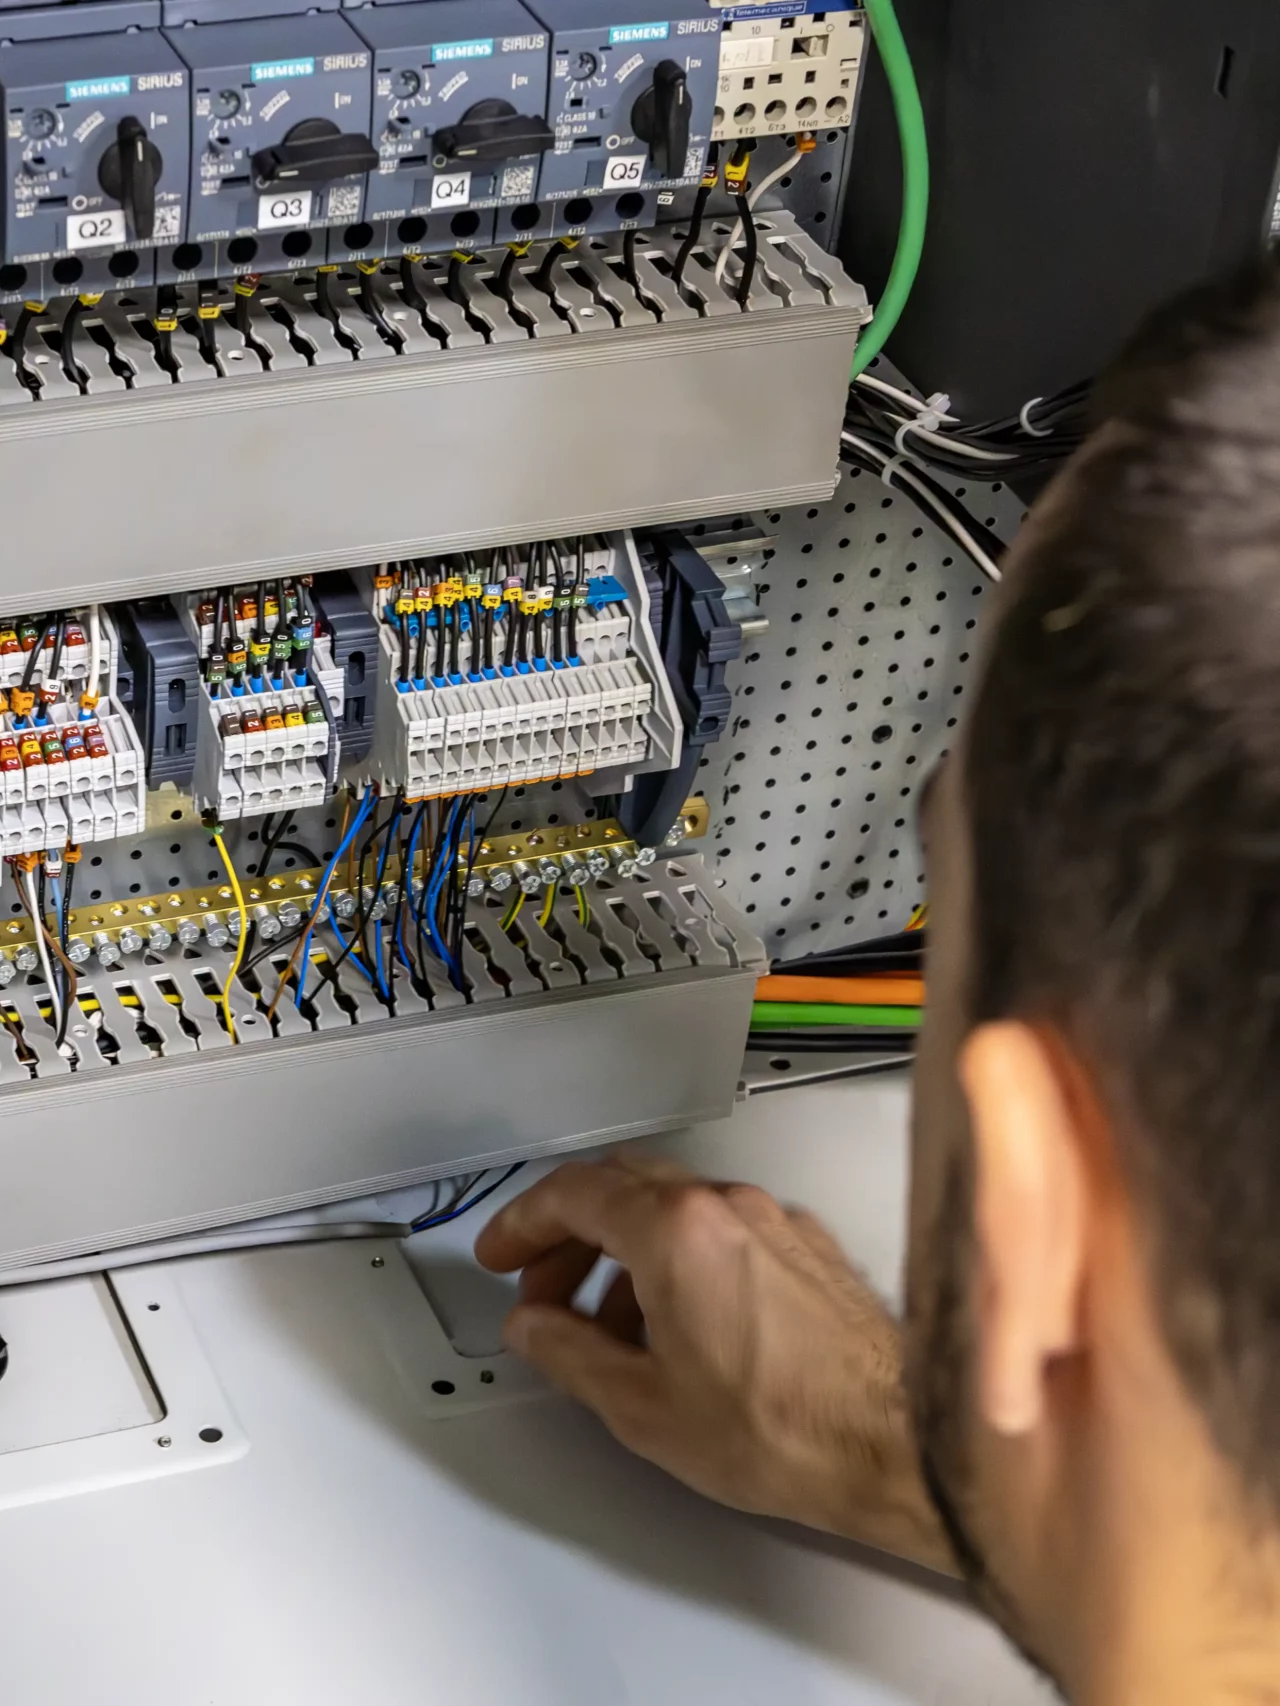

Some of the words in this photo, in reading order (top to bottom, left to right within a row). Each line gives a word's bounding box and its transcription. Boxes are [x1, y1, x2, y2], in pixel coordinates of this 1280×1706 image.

[612, 26, 667, 42] SIEMENS
[676, 19, 719, 36] SIRIUS
[751, 25, 762, 36] 10
[434, 44, 492, 61] SIEMENS
[501, 34, 545, 53] SIRIUS
[254, 63, 314, 80] SIEMENS
[322, 53, 368, 72] SIRIUS
[69, 82, 128, 98] SIEMENS
[137, 72, 183, 91] SIRIUS
[836, 114, 851, 125] A2
[610, 162, 641, 181] Q5
[435, 179, 467, 200] Q4
[270, 198, 303, 219] Q3
[78, 217, 113, 240] Q2
[401, 591, 414, 608] 41
[418, 590, 430, 607] 42
[487, 587, 499, 605] 46
[526, 593, 538, 612] 48
[560, 588, 571, 607] 50
[574, 586, 589, 605] 51
[300, 617, 313, 647] 560
[256, 636, 272, 662] 540
[275, 634, 288, 658] 550
[232, 643, 247, 670] 530
[211, 654, 225, 682] 510
[44, 684, 59, 701] 29
[245, 711, 260, 727] 21
[23, 733, 42, 760] 242
[45, 732, 64, 759] 252
[67, 727, 85, 754] 262
[1, 738, 19, 766] 232
